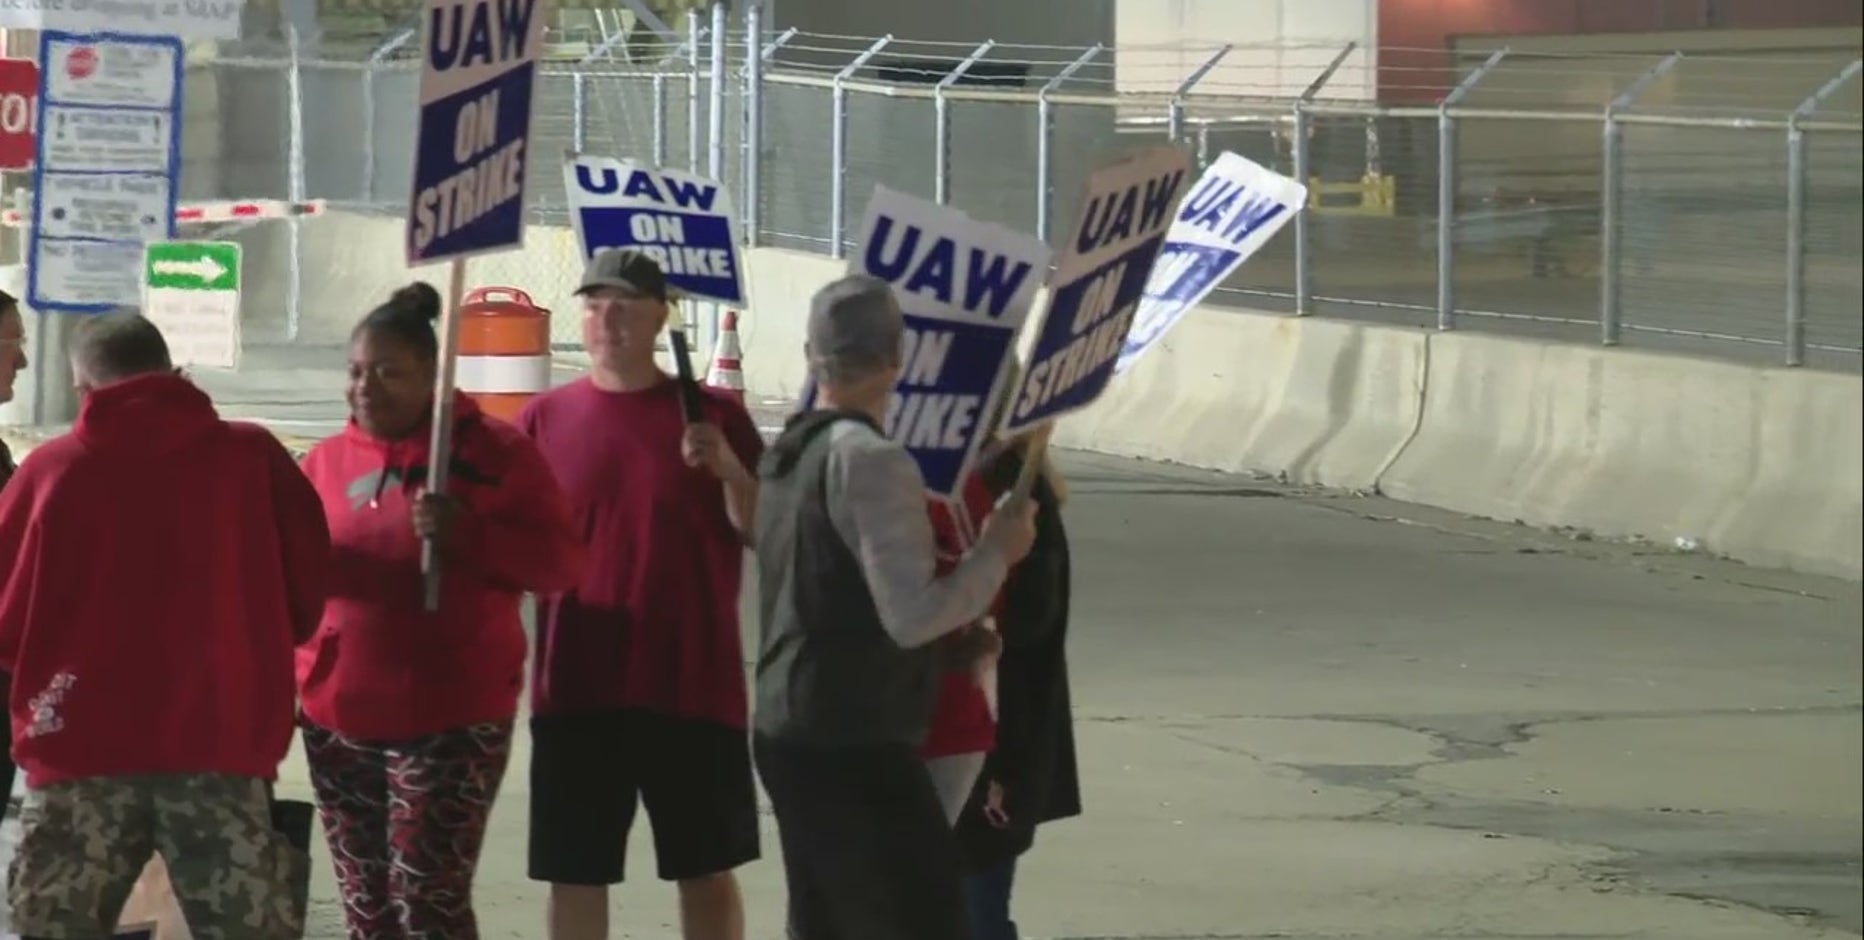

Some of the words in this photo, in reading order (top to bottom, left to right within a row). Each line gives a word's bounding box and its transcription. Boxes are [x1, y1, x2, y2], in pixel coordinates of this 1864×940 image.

[431, 0, 534, 71] UAW
[454, 87, 500, 164] ON
[415, 137, 524, 247] STRIKE
[576, 164, 717, 212] UAW
[1077, 169, 1184, 254] UAW
[1180, 177, 1286, 244] UAW
[593, 244, 732, 279] RIKE
[630, 213, 685, 244] ON
[865, 215, 1032, 318] UAW
[1072, 262, 1128, 334] ON
[1016, 303, 1136, 418] STRIKE
[884, 391, 980, 450] IKE
